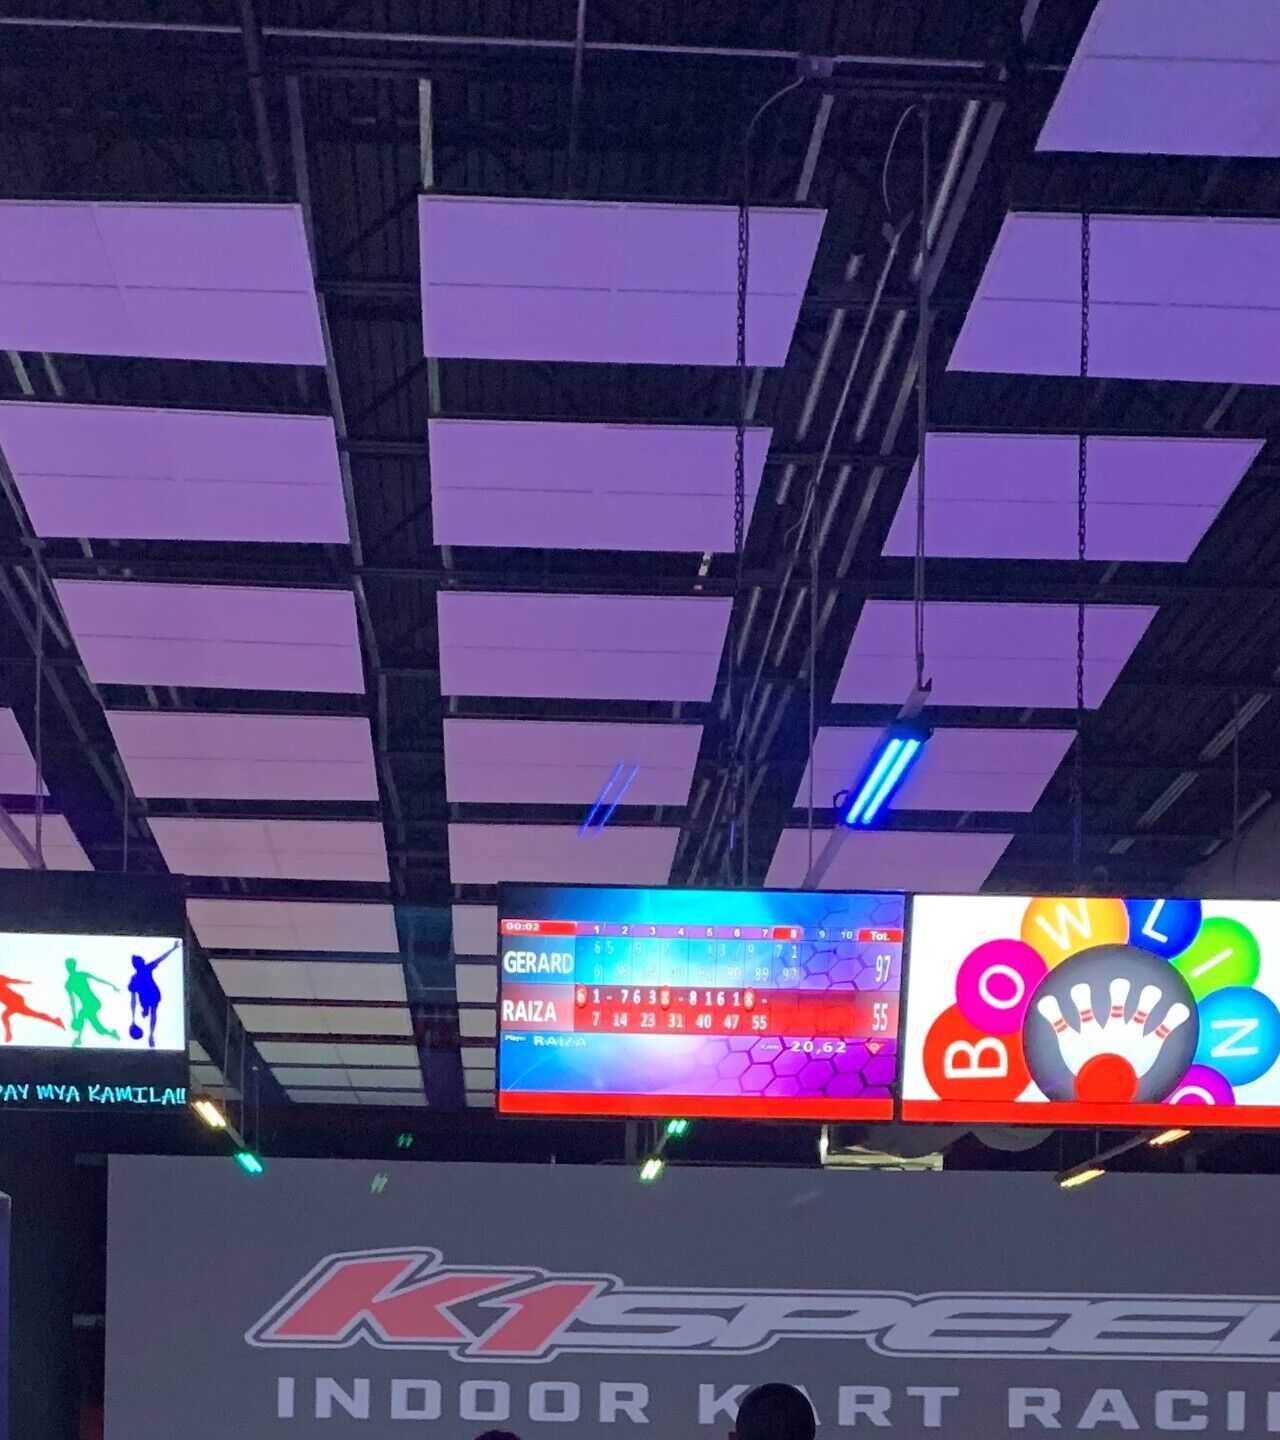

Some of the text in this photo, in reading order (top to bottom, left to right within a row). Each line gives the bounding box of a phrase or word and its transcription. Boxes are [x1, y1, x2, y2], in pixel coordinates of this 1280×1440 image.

[594, 925, 600, 934] 1
[622, 926, 628, 934] 2
[650, 926, 656, 935] 3
[677, 927, 684, 936] 4
[706, 928, 713, 936] 5
[734, 929, 741, 937] 6
[762, 929, 769, 937] 7
[790, 930, 797, 939] 8
[819, 930, 826, 939] 9
[841, 930, 853, 939] 10
[503, 951, 574, 974] GERARD
[876, 955, 891, 982] 97
[503, 1000, 557, 1023] RAIZA
[593, 1012, 767, 1030] 7 14 23 31 40 47 55
[872, 1003, 888, 1031] 55
[533, 1036, 588, 1048] RAIZA
[36, 1084, 80, 1102] MYA
[277, 1376, 650, 1424] INDOOR
